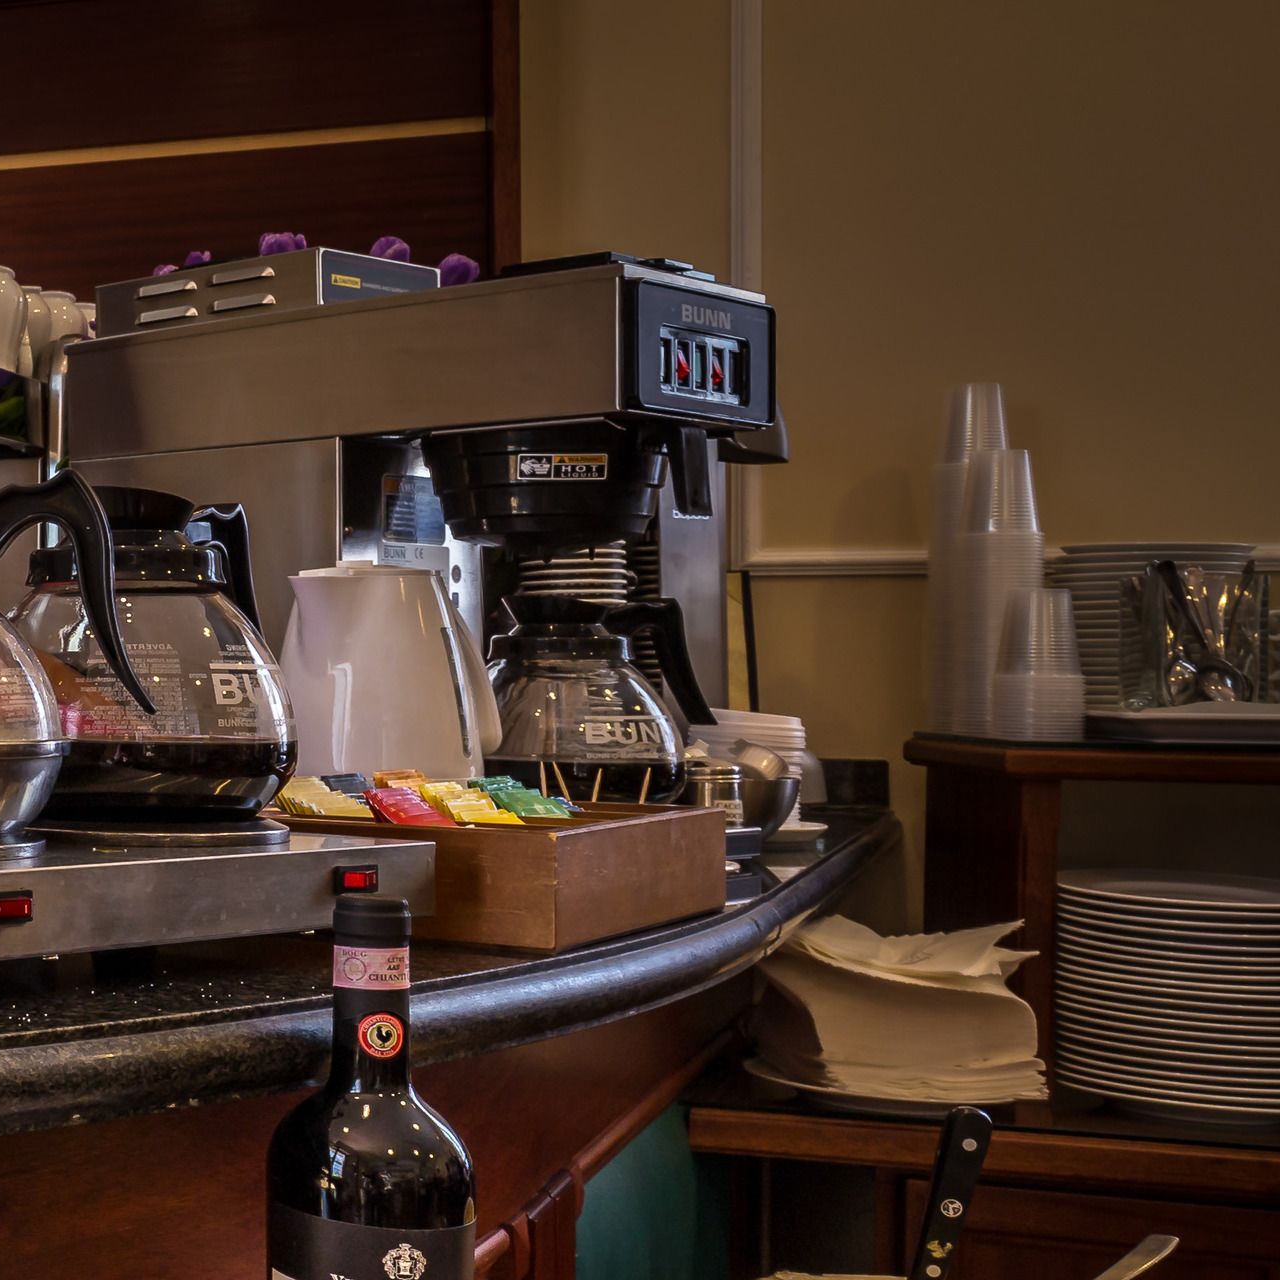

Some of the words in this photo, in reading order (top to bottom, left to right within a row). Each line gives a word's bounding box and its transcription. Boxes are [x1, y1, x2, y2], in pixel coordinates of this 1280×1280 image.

[681, 303, 732, 330] BUNN
[561, 464, 599, 473] HOT
[584, 721, 662, 745] BUN
